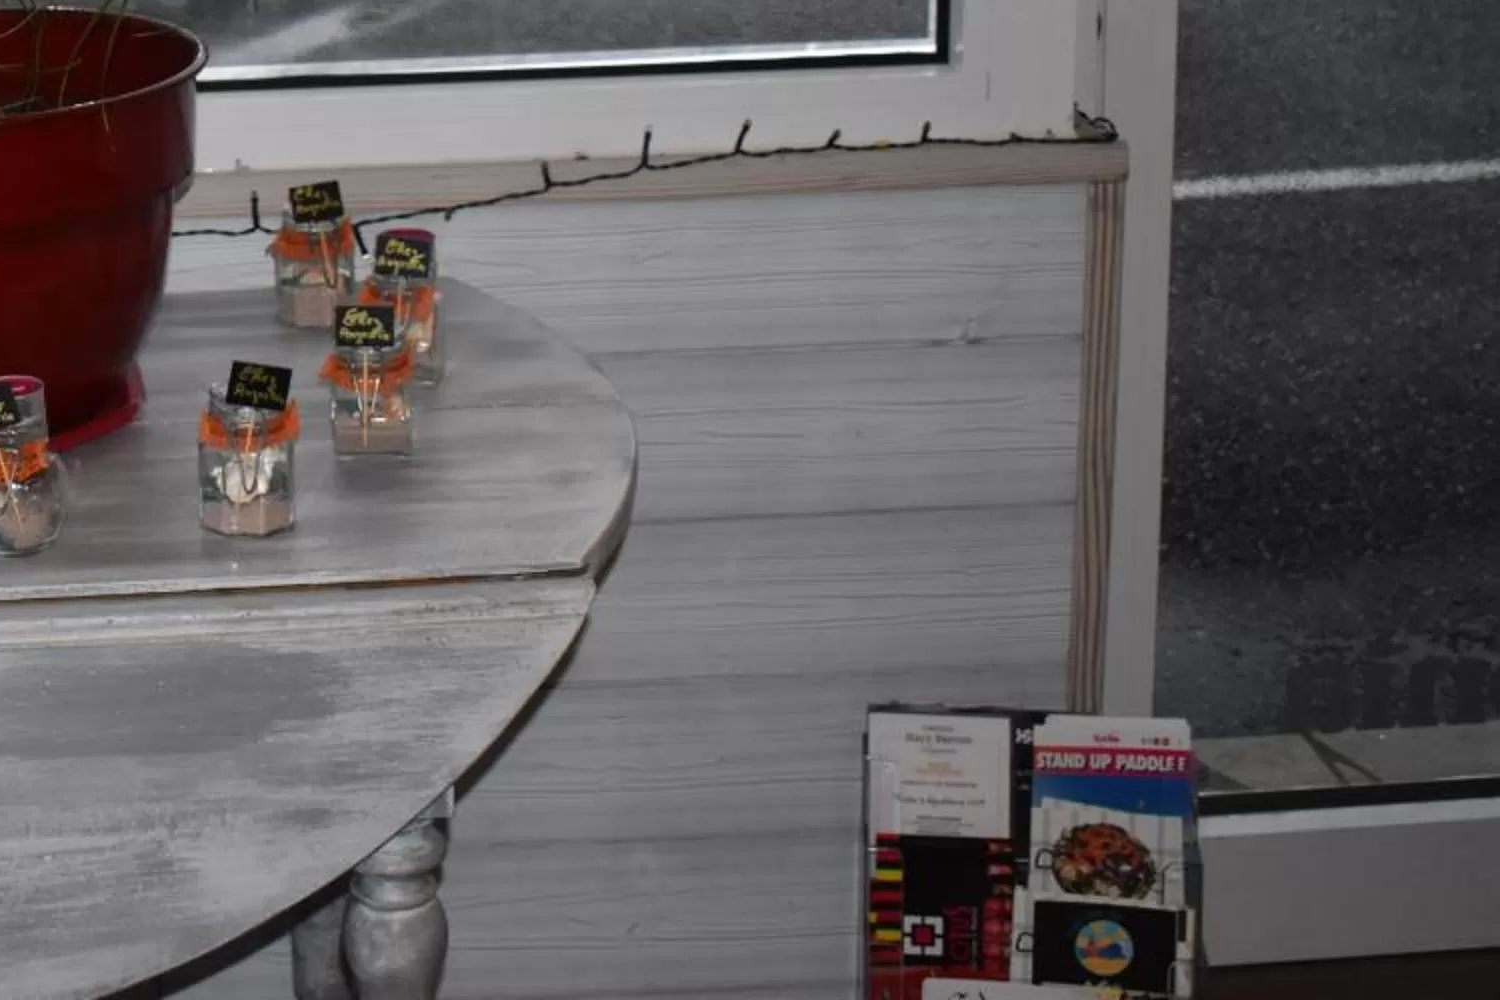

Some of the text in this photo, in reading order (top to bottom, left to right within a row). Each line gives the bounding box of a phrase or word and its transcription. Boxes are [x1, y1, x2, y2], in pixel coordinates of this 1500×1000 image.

[1035, 752, 1086, 769] STAND
[1089, 753, 1113, 770] UP
[1115, 754, 1175, 772] PADDLE
